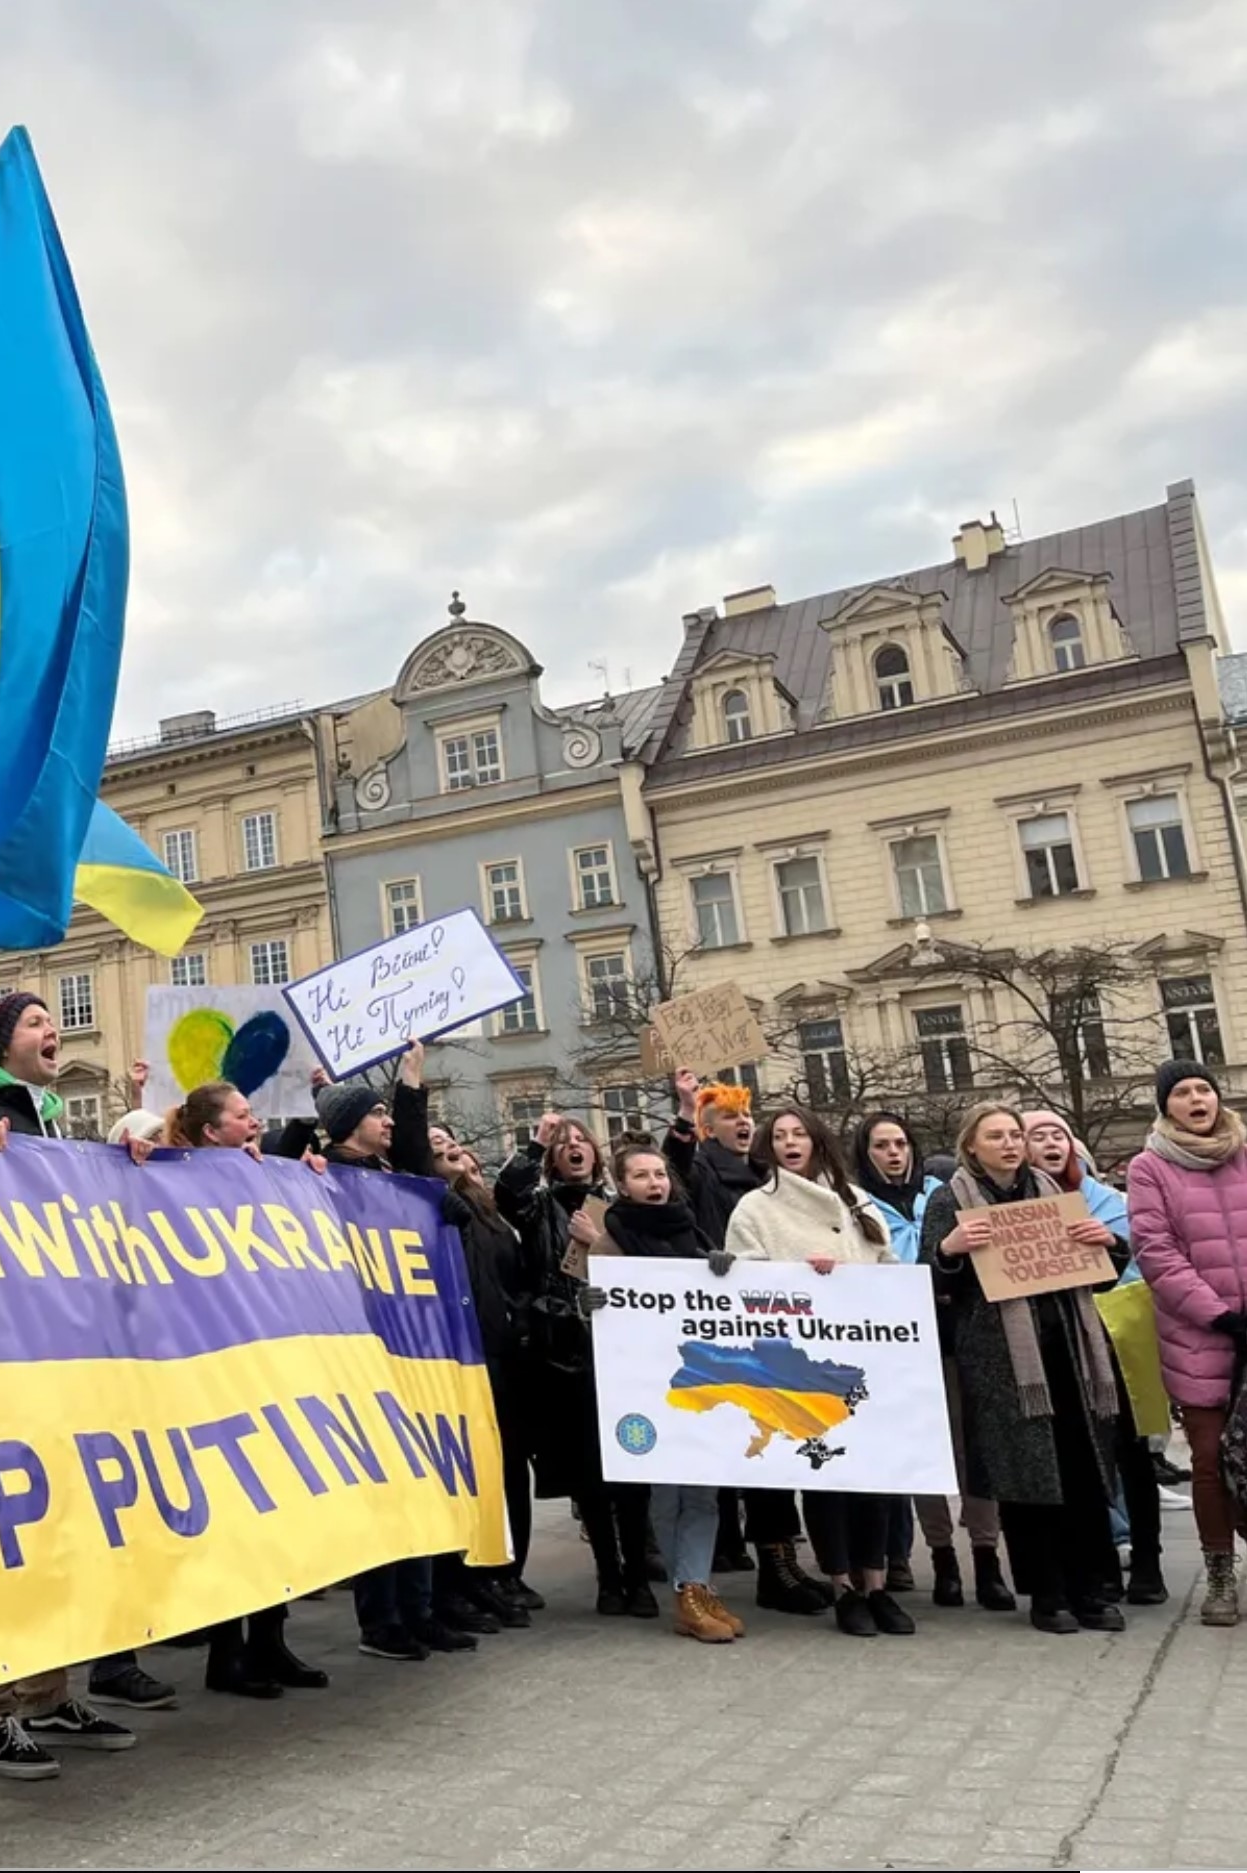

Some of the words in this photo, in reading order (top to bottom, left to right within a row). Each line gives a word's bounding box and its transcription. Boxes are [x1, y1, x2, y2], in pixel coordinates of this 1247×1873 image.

[989, 1202, 1060, 1228] RUSSIAN
[1003, 1244, 1035, 1264] GO
[1036, 1238, 1081, 1259] FUCK
[609, 1287, 676, 1314] Stop
[684, 1289, 732, 1311] the
[738, 1289, 814, 1315] WAR
[681, 1315, 788, 1340] against
[797, 1318, 920, 1343] Ukraine!
[74, 1394, 388, 1549] PUTIN
[373, 1391, 479, 1497] NW
